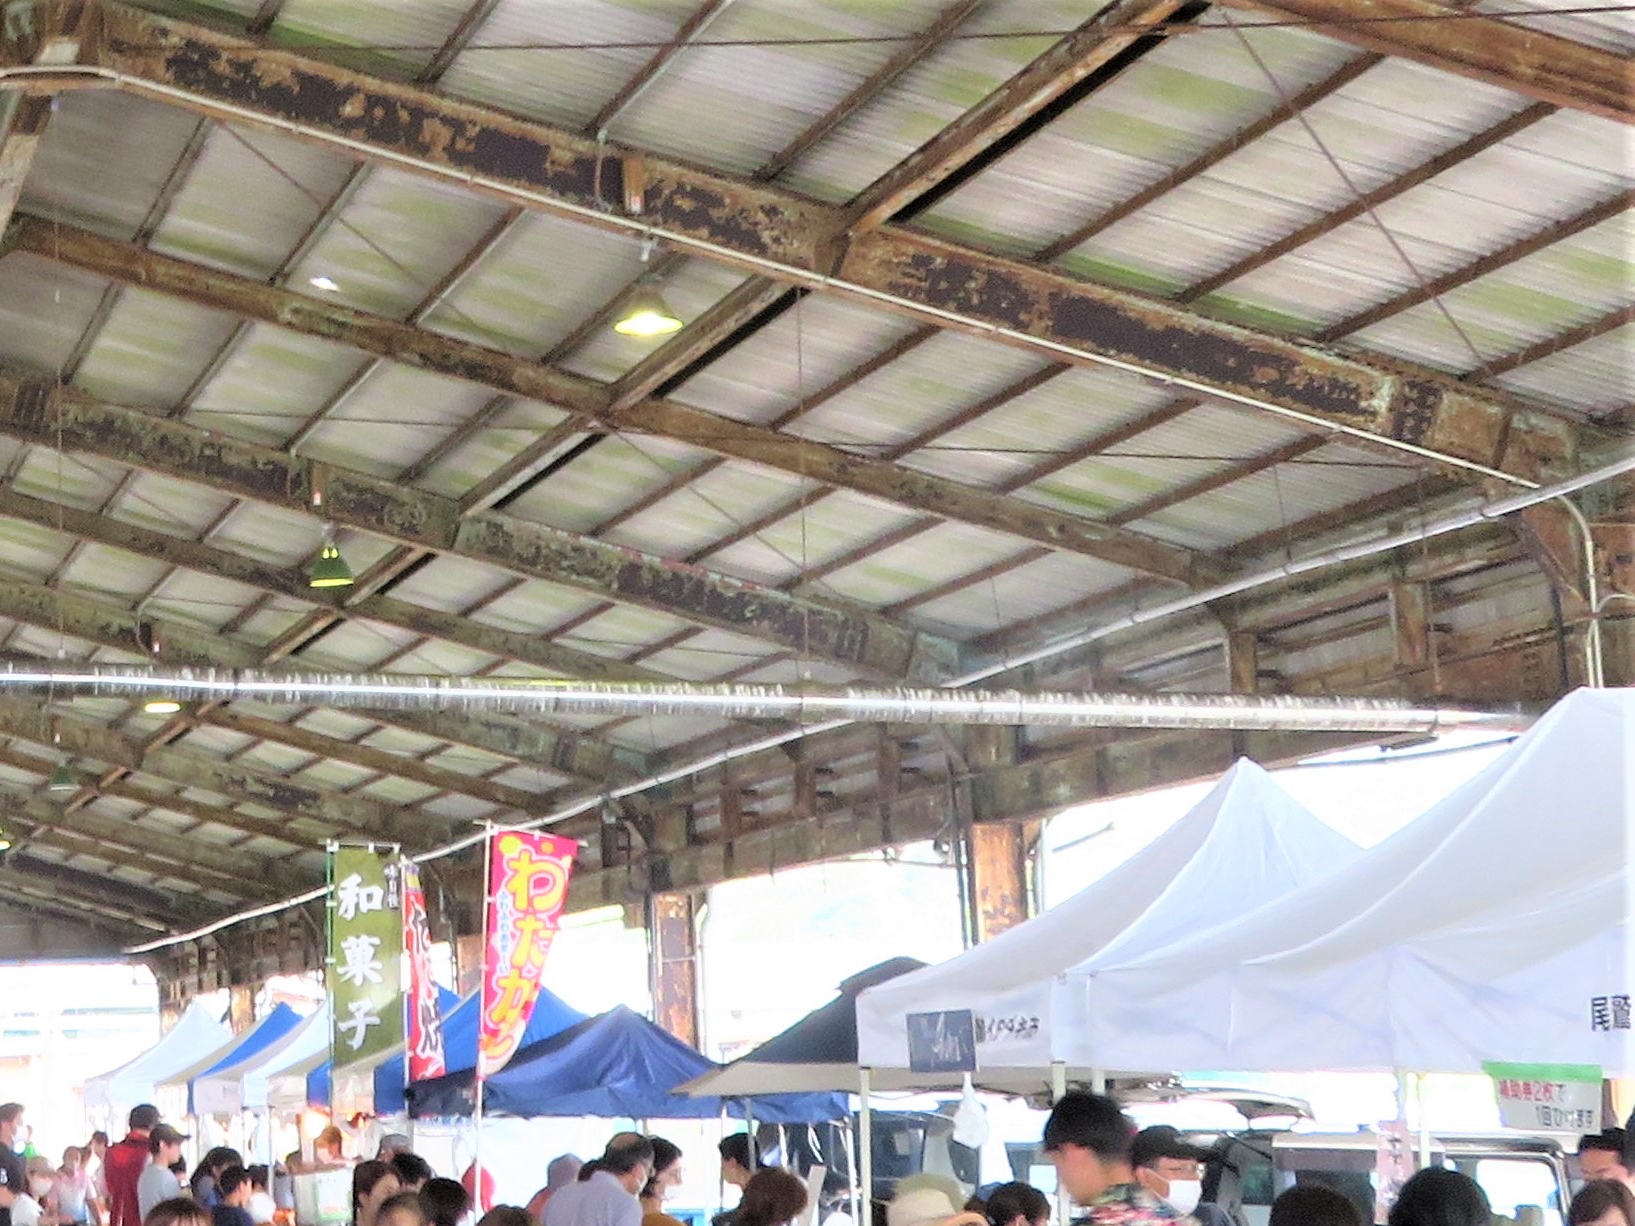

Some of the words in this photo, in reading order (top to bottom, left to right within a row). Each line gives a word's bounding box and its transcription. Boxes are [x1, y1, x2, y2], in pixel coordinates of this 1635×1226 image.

[337, 872, 384, 1051] 和菓子
[1590, 994, 1632, 1032] 尾鷲
